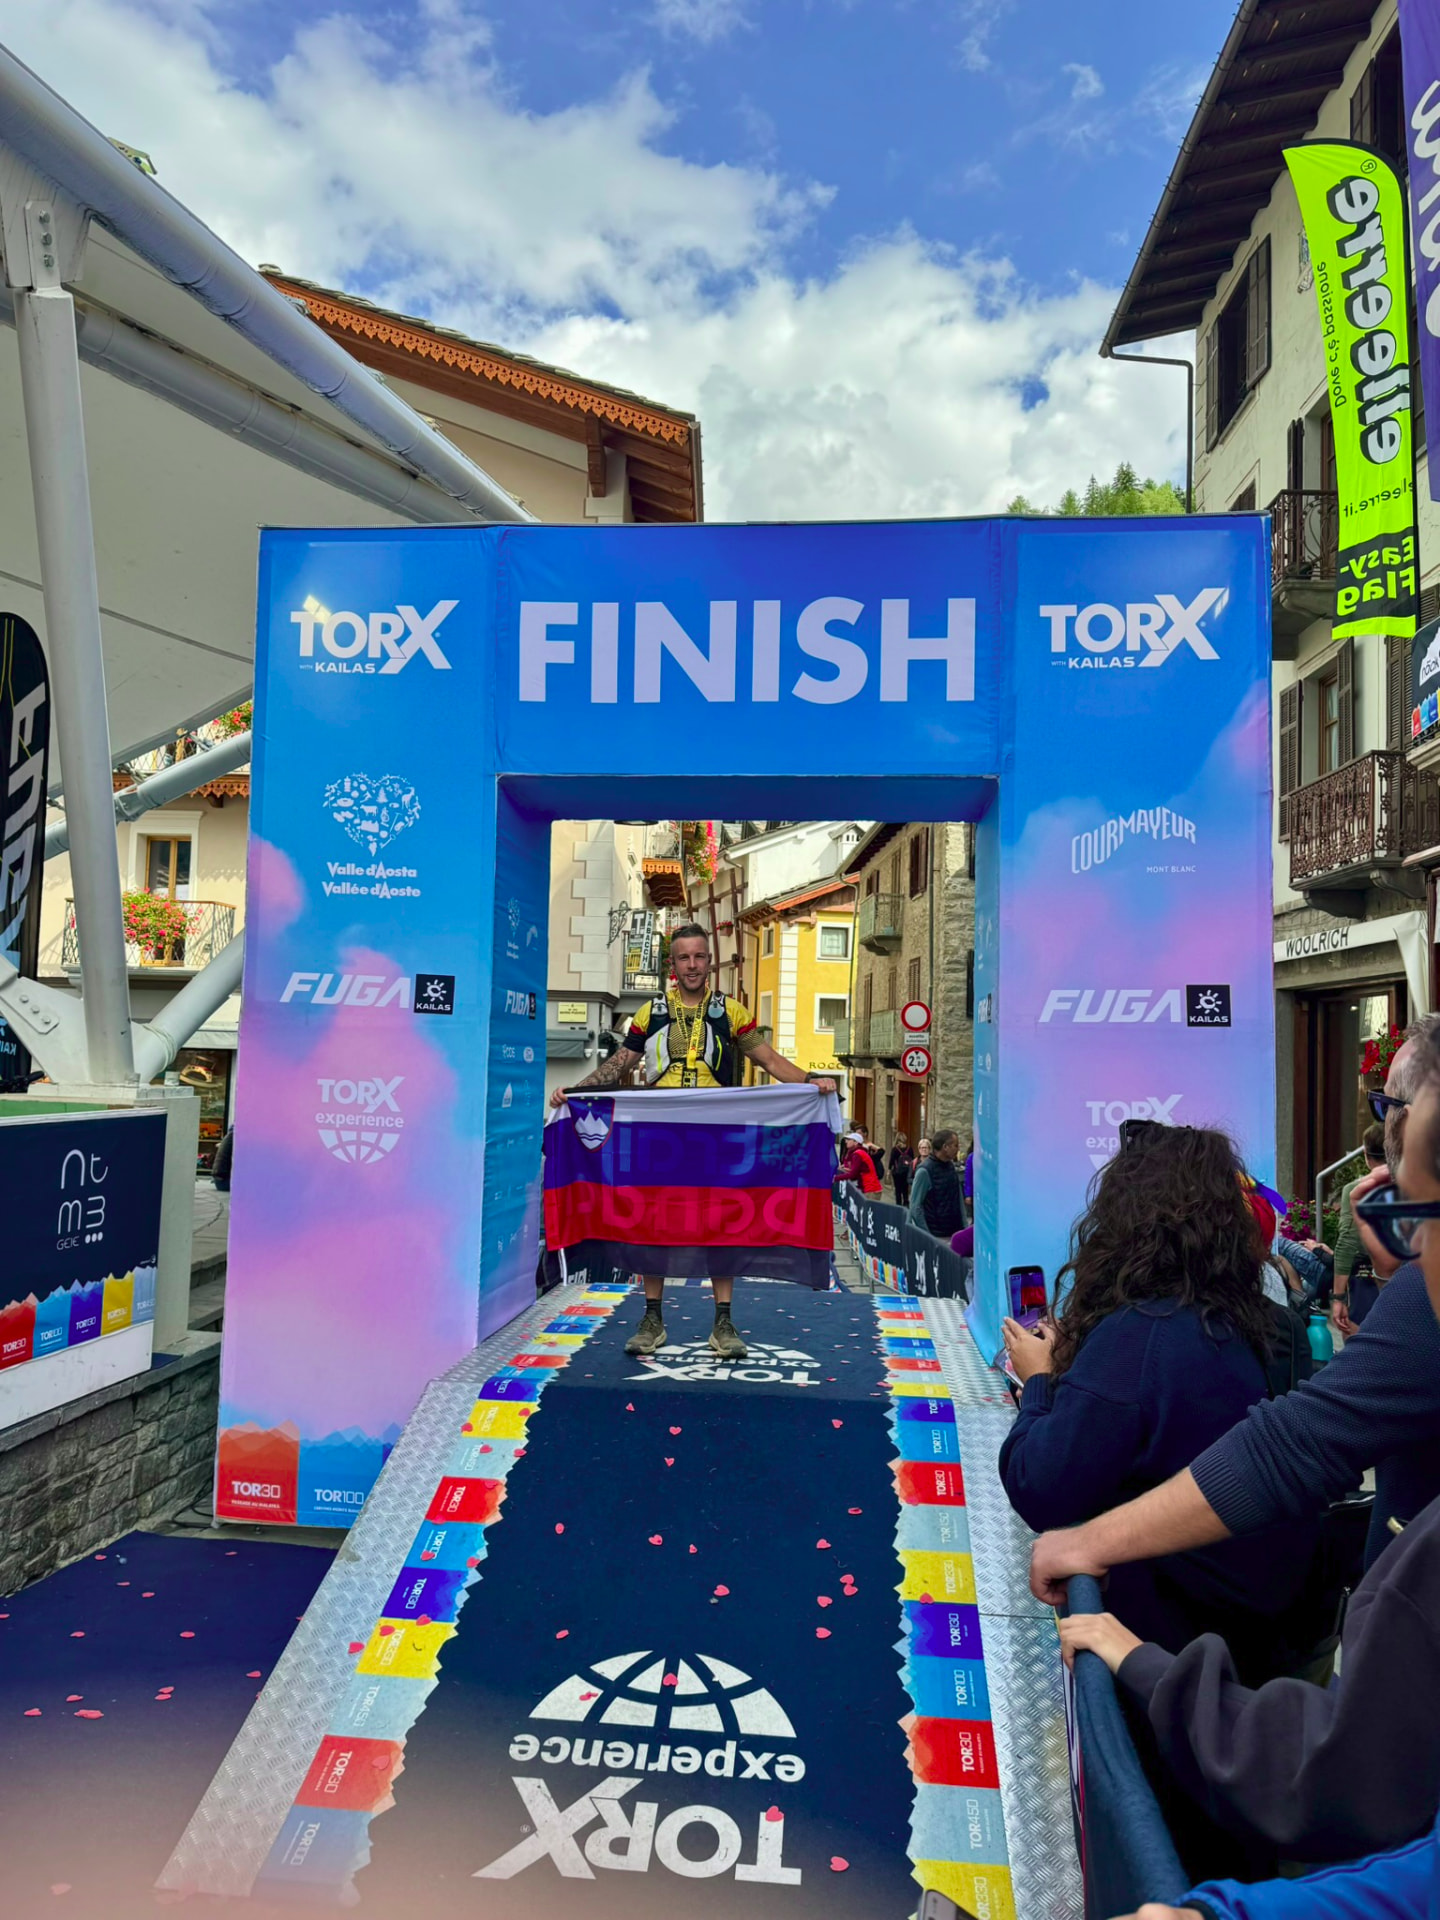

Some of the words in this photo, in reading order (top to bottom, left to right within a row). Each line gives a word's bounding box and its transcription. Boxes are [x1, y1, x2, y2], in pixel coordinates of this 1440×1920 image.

[290, 600, 460, 674] TORX
[1039, 588, 1226, 667] TORX
[518, 596, 976, 705] FINISH
[1068, 656, 1136, 669] KAILAS
[315, 662, 376, 674] KAILAS
[1071, 805, 1196, 874] COURMAYEUR
[326, 861, 365, 878] Valle
[366, 861, 418, 879] d'Aosta
[1146, 865, 1169, 873] MONT
[1170, 865, 1196, 873] BLANC
[322, 881, 369, 897] Vallée
[370, 881, 422, 899] d'Aoste
[642, 912, 653, 970] TABACCHI
[1286, 926, 1350, 958] WOOLRICH
[279, 972, 411, 1009] FUGA
[416, 1002, 452, 1011] KAILAS
[1038, 989, 1182, 1023] FUGA
[1189, 1015, 1229, 1023] KAILAS
[317, 1076, 406, 1113] TORX
[315, 1112, 405, 1128] experience
[56, 1235, 80, 1250] GEIE
[622, 1362, 821, 1385] TORX
[636, 1354, 822, 1368] experience
[231, 1480, 281, 1499] TOR30
[314, 1488, 365, 1505] TOR100
[447, 1485, 467, 1513] TOR30
[935, 1469, 947, 1497] TOR30
[949, 1612, 962, 1647] TOR130
[954, 1669, 968, 1707] TOR100
[353, 1685, 381, 1728] TOR450
[509, 1734, 807, 1783] experience
[959, 1731, 975, 1773] TOR30
[324, 1750, 353, 1793] TOR30
[471, 1775, 802, 1886] TORX
[966, 1799, 983, 1849] TOR450
[973, 1876, 991, 1920] OR330
